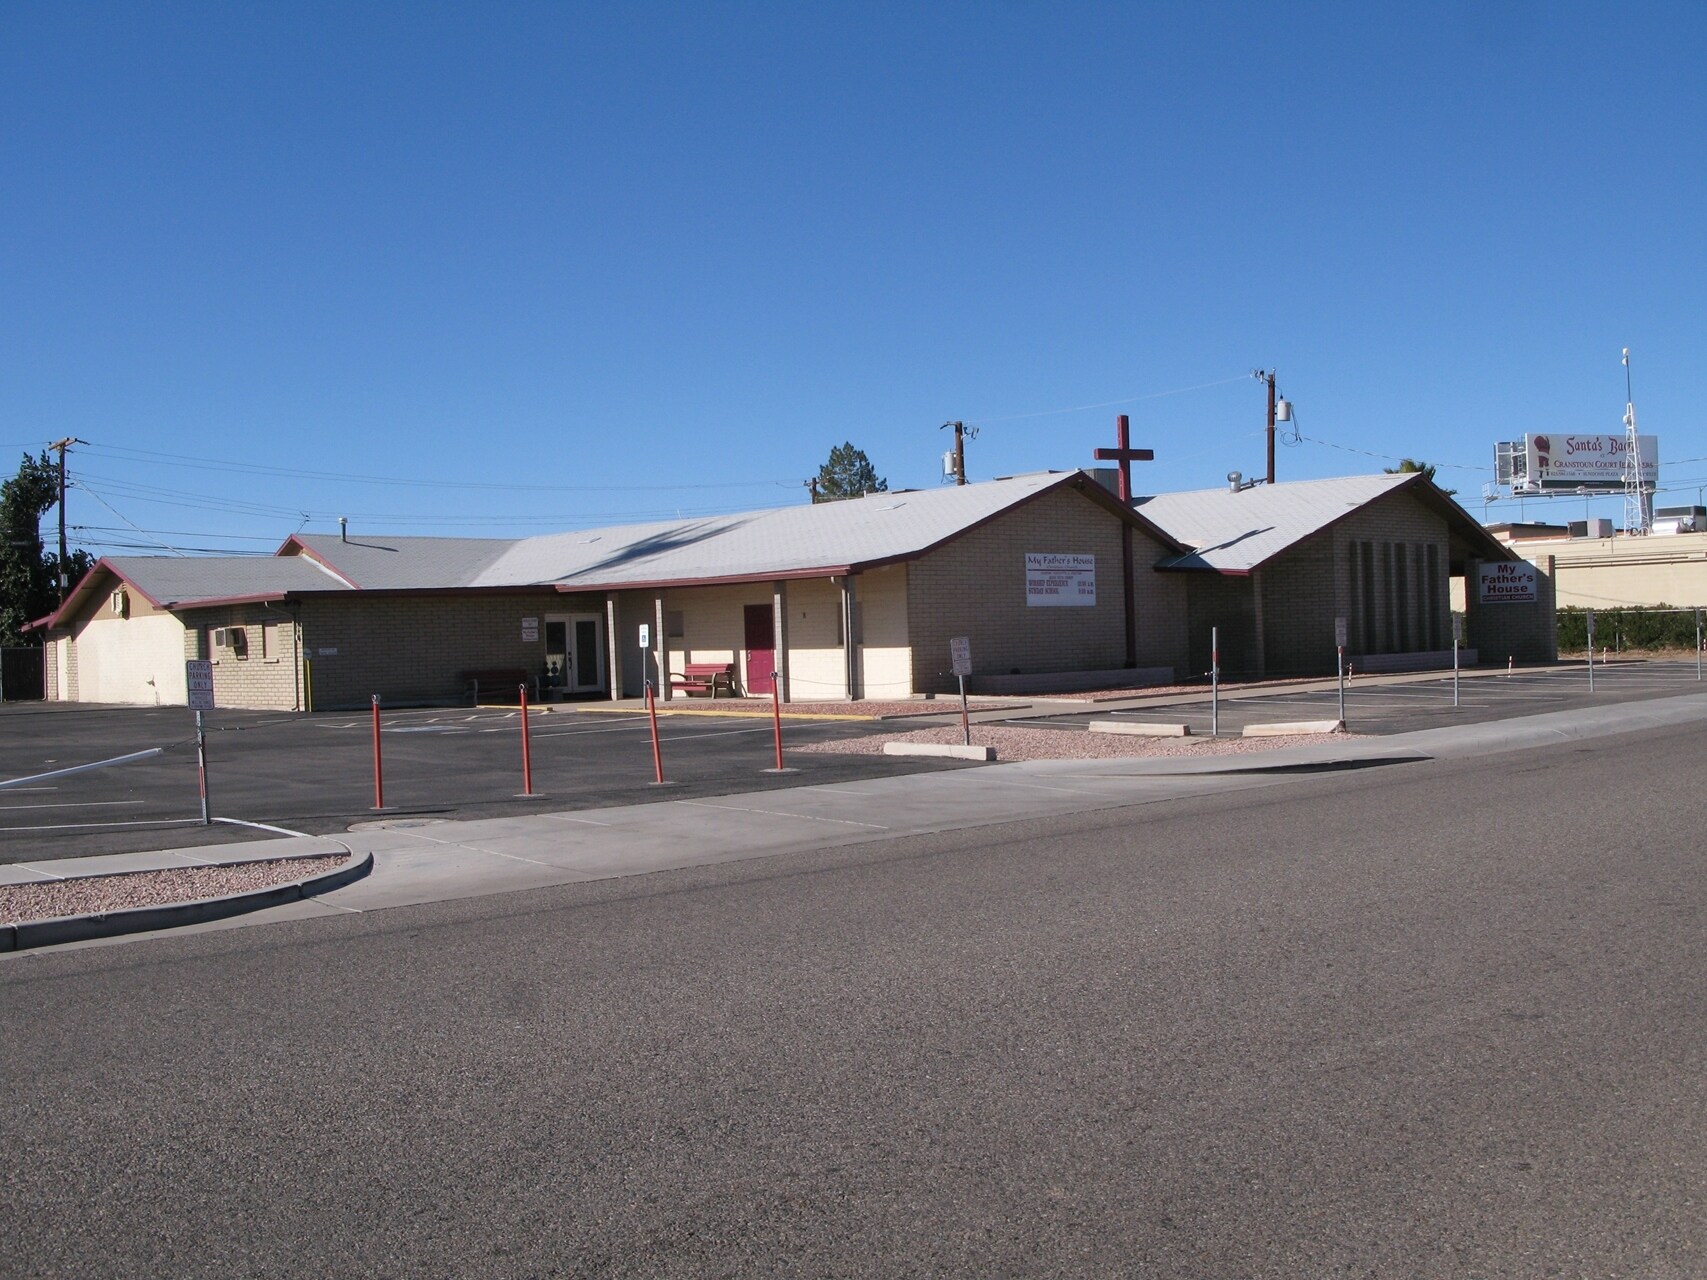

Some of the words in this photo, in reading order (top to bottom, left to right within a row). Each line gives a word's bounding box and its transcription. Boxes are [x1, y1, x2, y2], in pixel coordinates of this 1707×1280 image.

[1566, 436, 1602, 455] Santa's
[1607, 436, 1635, 455] Bac
[1553, 460, 1594, 469] CRANSTOUN
[1595, 460, 1617, 469] COURT
[1028, 556, 1041, 567] My
[1043, 555, 1071, 565] Father's
[1072, 557, 1094, 565] House
[1497, 564, 1516, 575] My
[1481, 573, 1534, 584] Father's
[1487, 585, 1528, 594] House
[188, 662, 211, 671] CHURCH
[189, 671, 212, 680] PARKING
[193, 681, 208, 689] ONLY
